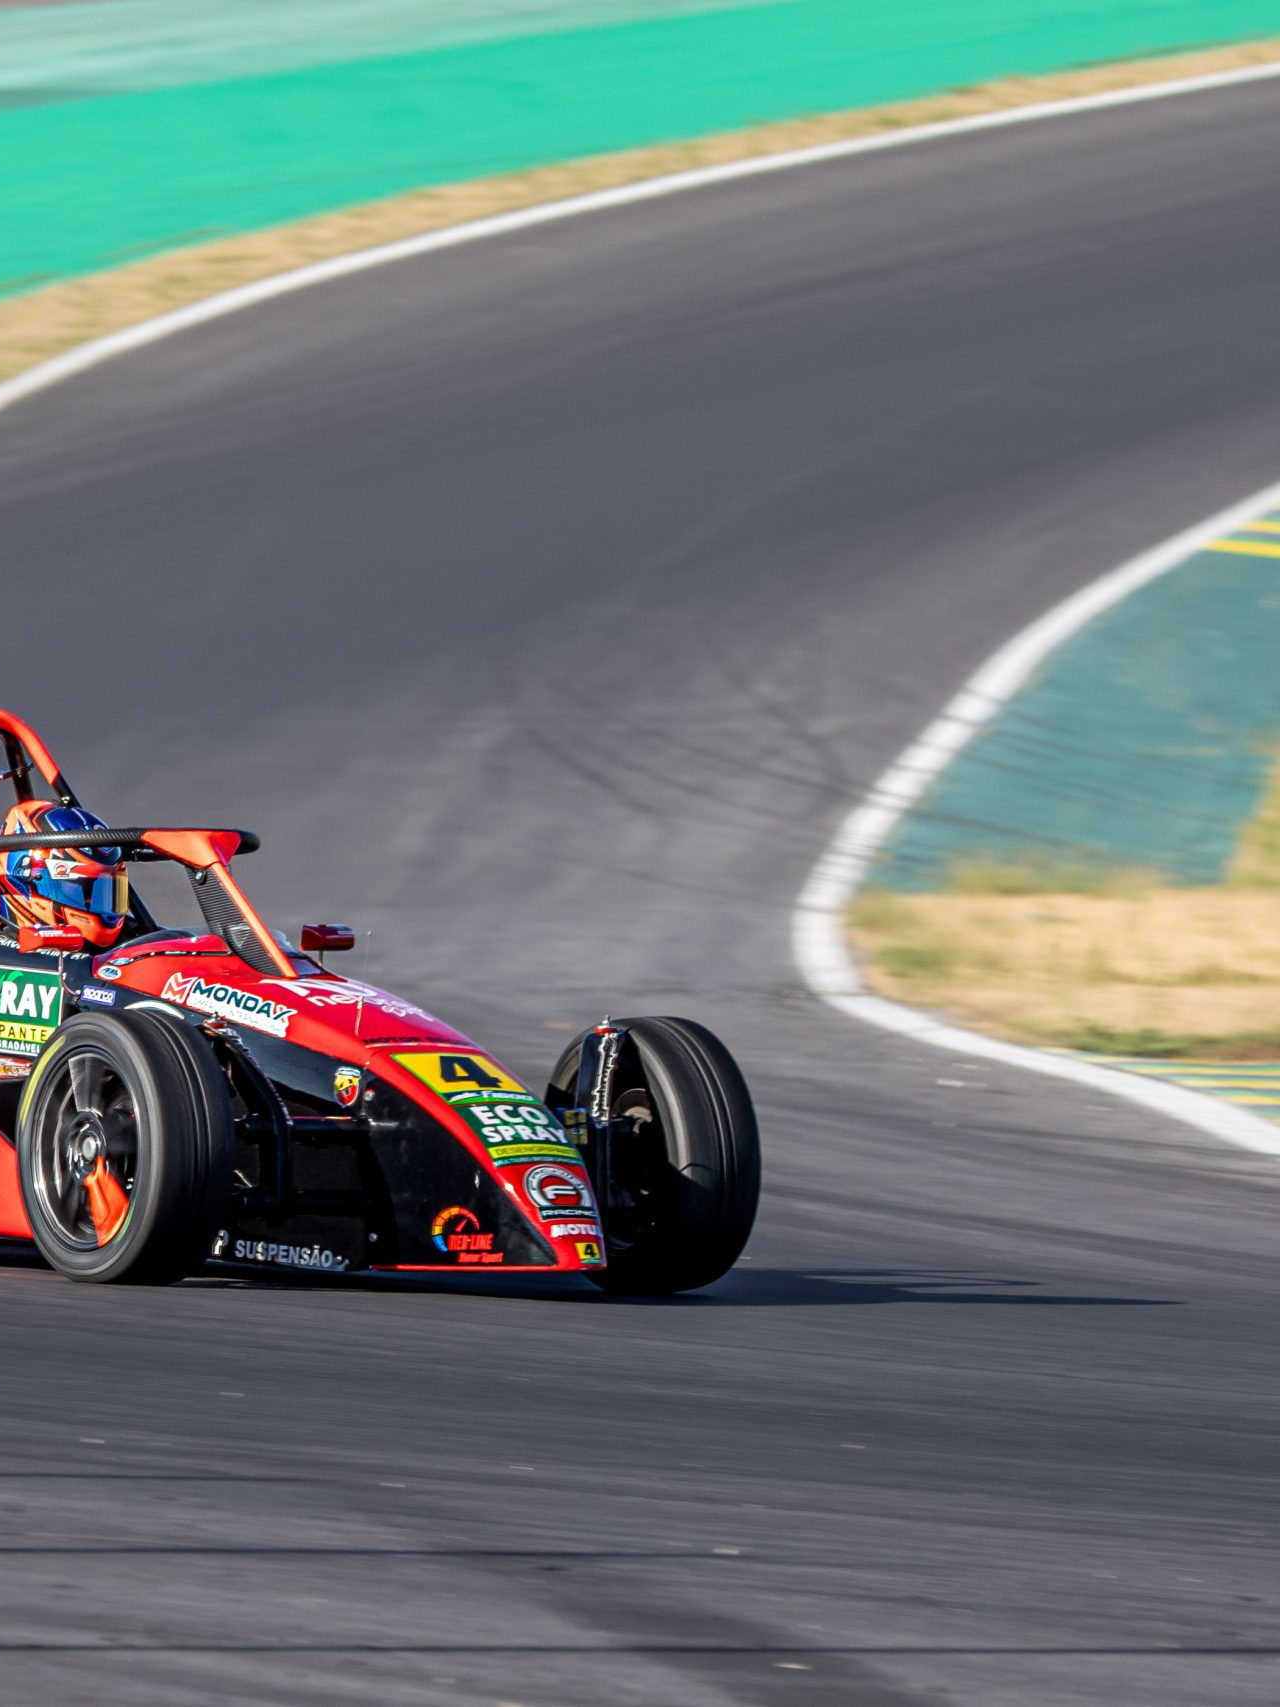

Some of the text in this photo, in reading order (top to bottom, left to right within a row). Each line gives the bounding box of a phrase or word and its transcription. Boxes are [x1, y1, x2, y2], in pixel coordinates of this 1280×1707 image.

[439, 1056, 505, 1088] 4
[472, 1105, 549, 1125] ECO
[482, 1124, 568, 1143] SPRAY
[234, 1239, 333, 1268] SUSPENSÃO
[584, 1243, 598, 1258] 4
